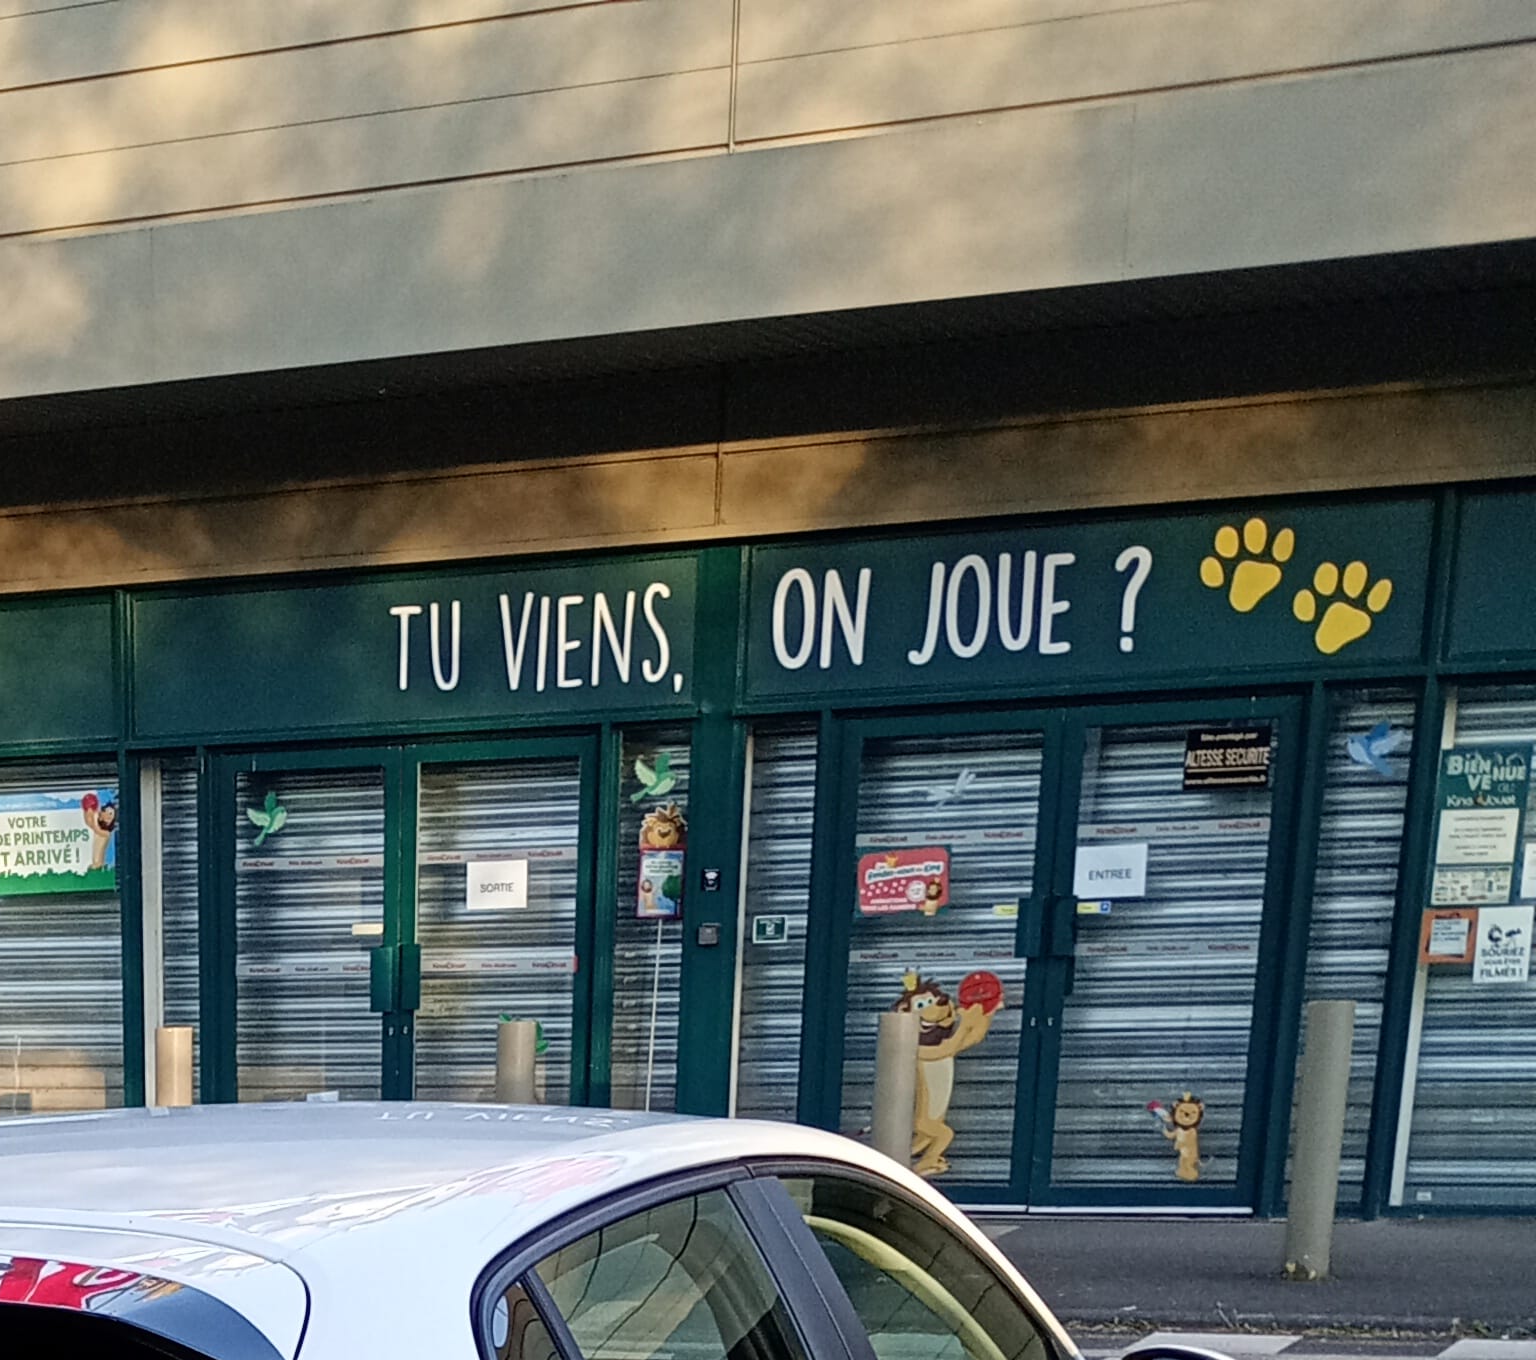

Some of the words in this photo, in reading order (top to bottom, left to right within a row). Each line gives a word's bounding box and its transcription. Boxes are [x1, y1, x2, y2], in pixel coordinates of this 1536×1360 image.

[772, 566, 872, 670] ON
[907, 550, 1076, 666] JOUE
[1114, 545, 1153, 654] ?
[389, 600, 462, 692] TU
[499, 582, 684, 693] VIENS,
[7, 815, 47, 829] VOTRE
[14, 828, 90, 847] PRINTEMPS
[14, 844, 72, 867] ARRIVÉ
[75, 847, 80, 864] !
[479, 881, 515, 894] SORTIE
